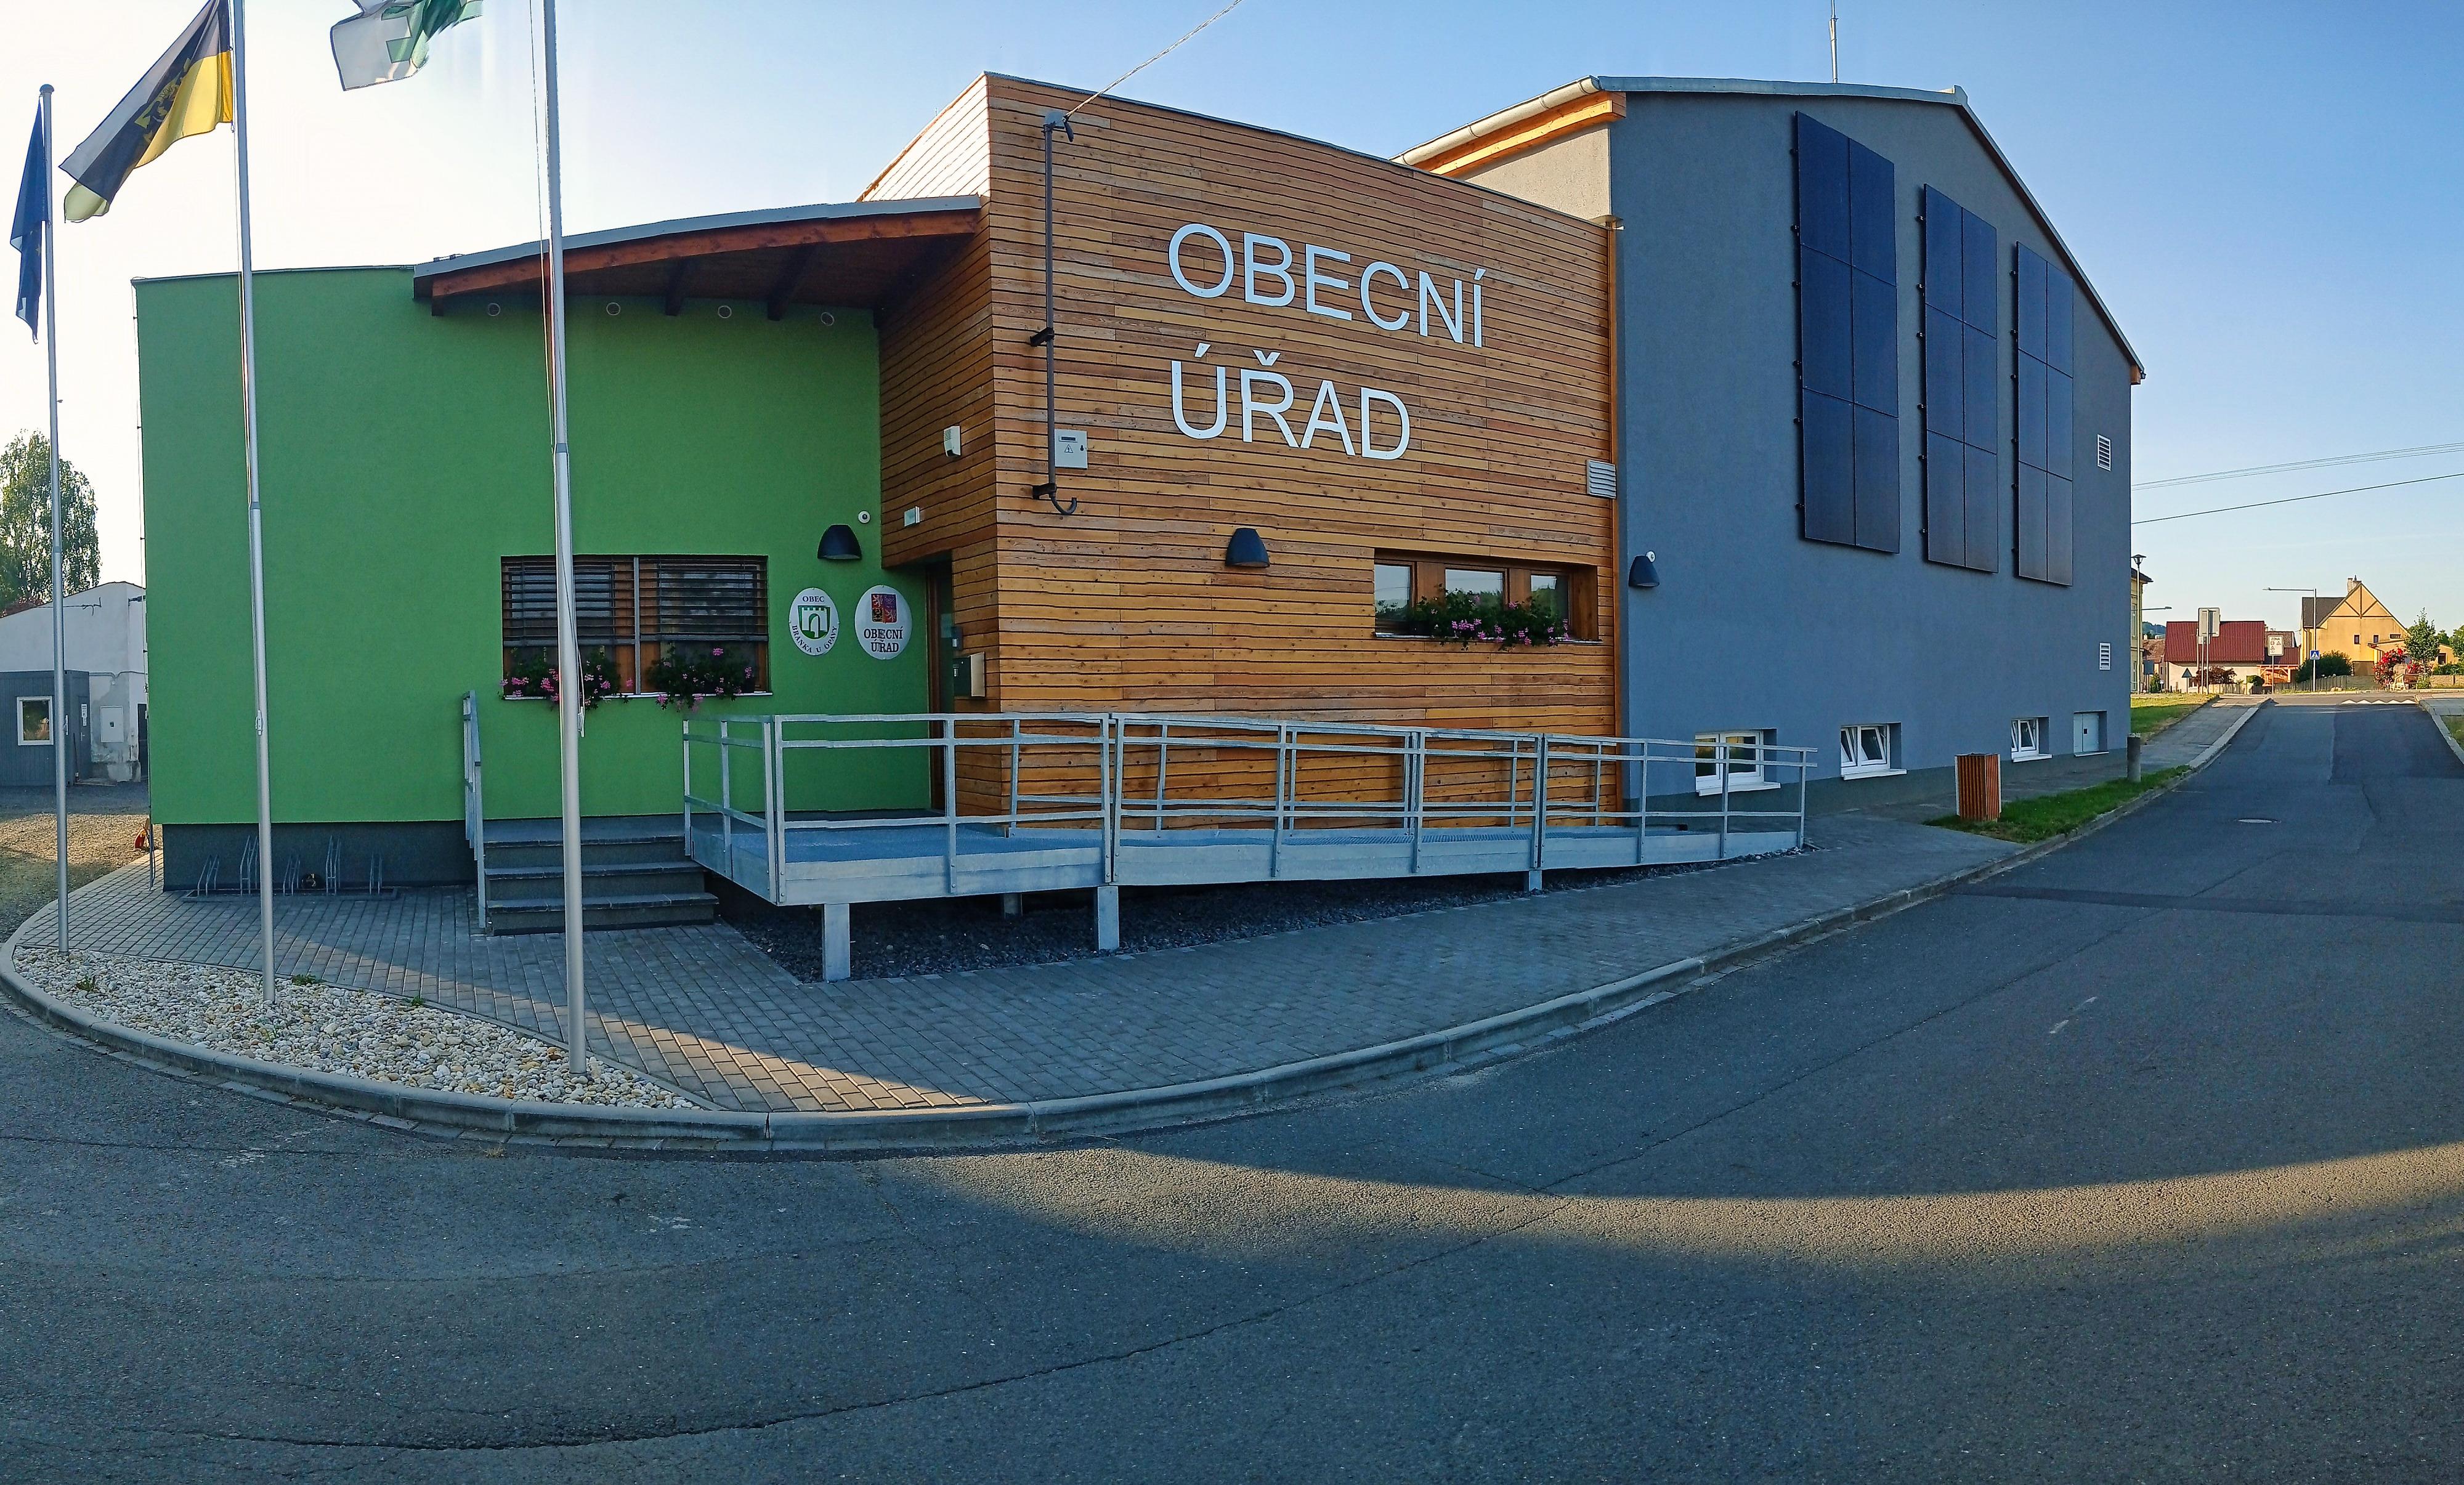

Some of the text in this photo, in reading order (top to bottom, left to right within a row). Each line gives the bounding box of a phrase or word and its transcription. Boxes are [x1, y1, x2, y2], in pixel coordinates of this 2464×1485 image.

[1169, 223, 1485, 347] OBECNÍ
[1171, 342, 1410, 460] ÚŘAD
[792, 625, 812, 653] BRANKA
[824, 626, 837, 649] OPAVY
[864, 626, 903, 639] OBECNÍ
[870, 639, 899, 653] ÚŘAD
